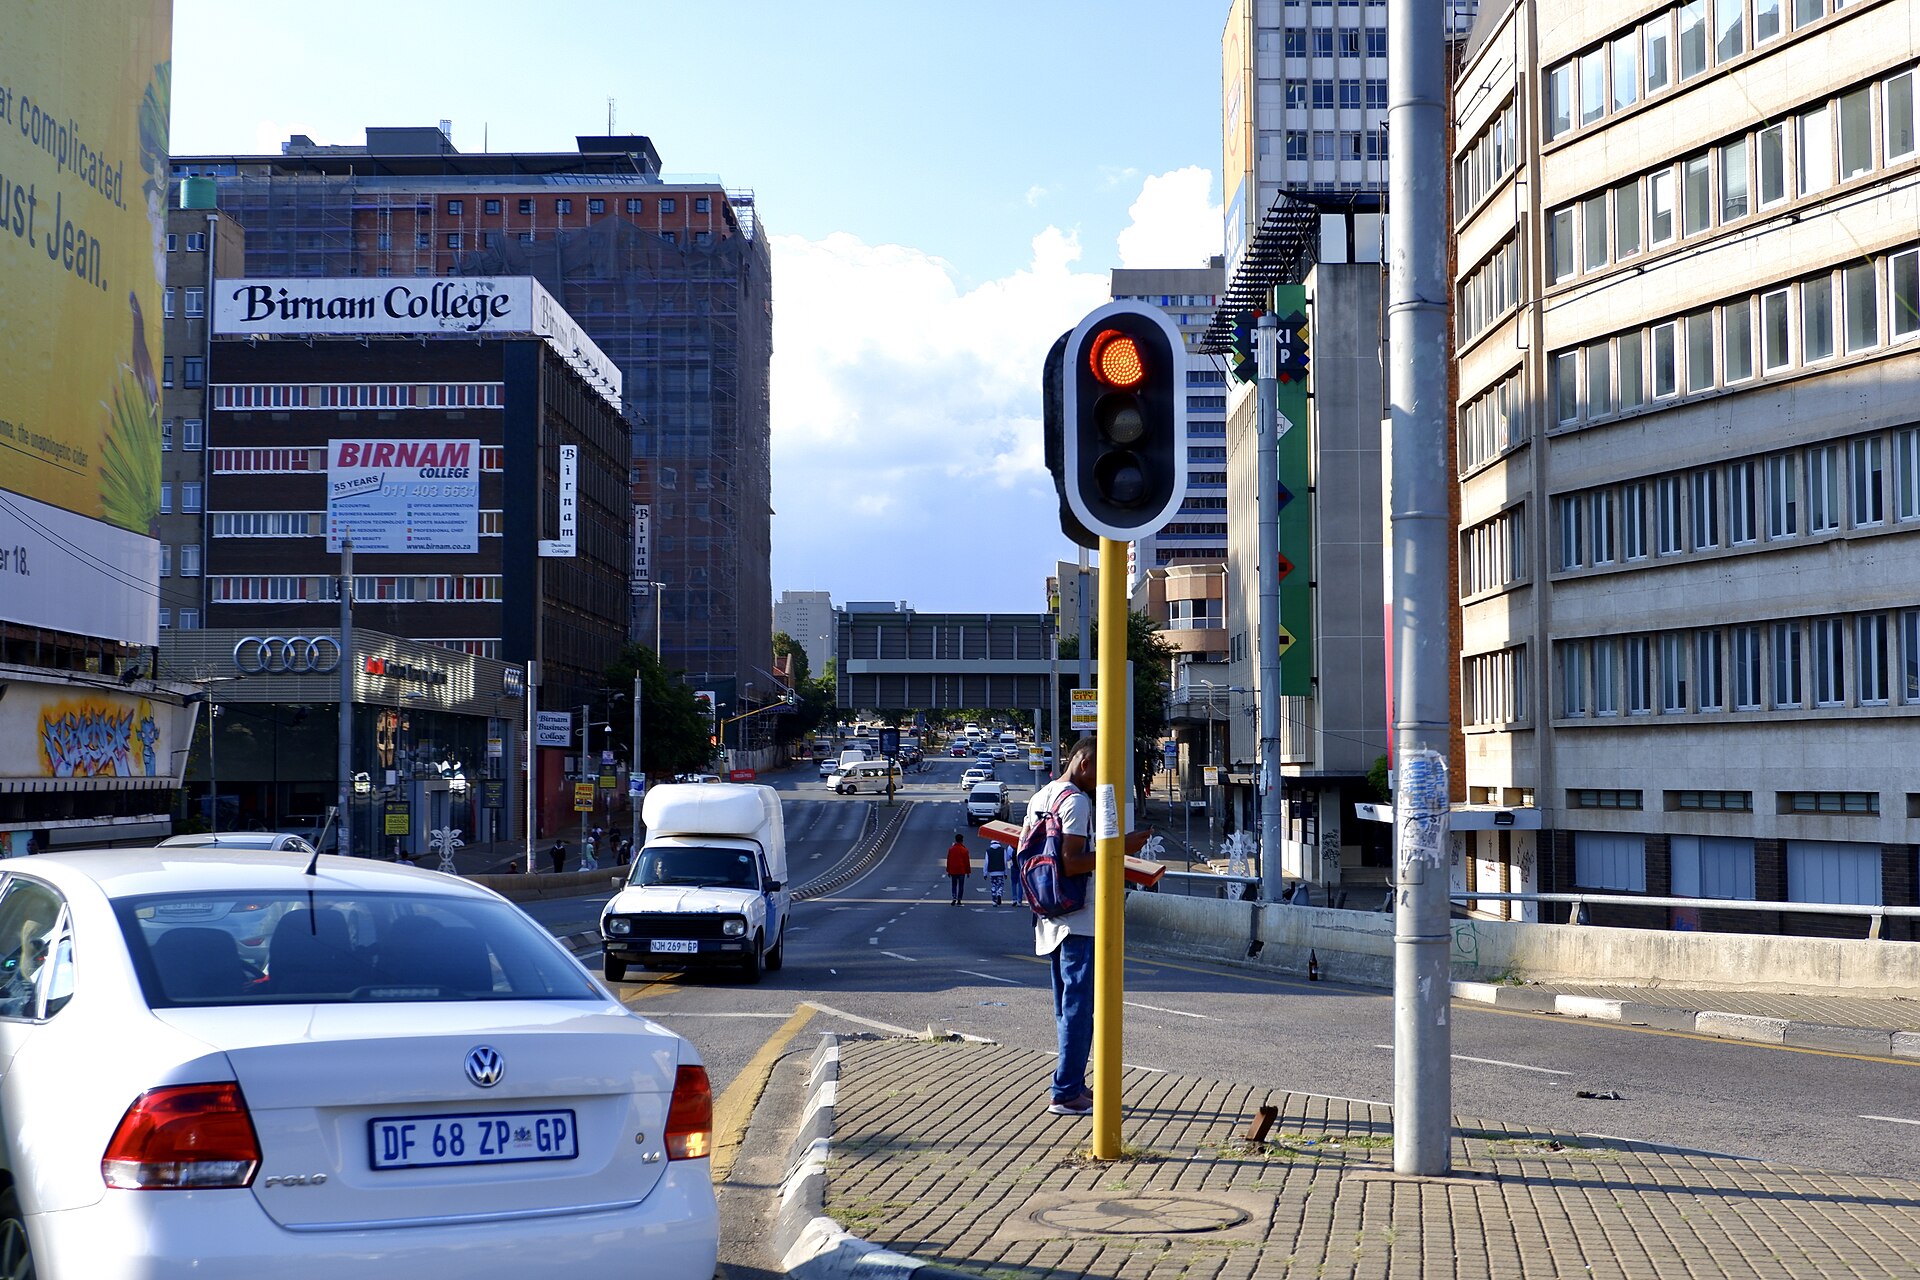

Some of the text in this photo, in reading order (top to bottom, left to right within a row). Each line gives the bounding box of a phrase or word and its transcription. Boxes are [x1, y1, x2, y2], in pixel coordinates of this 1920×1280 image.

[20, 96, 127, 211] complicated.
[47, 191, 107, 291] Jean.
[232, 281, 512, 332] Birnam College
[1250, 328, 1290, 344] PKI
[1250, 348, 1290, 364] TP
[337, 442, 470, 468] BIRNAM
[419, 468, 470, 478] COLLEGE
[334, 482, 346, 492] 55
[346, 475, 379, 488] YEARS
[382, 484, 408, 498] 011
[412, 484, 438, 498] 403
[442, 484, 477, 498] 6631
[562, 448, 575, 536] Birnam
[636, 508, 648, 577] Birnam
[13, 545, 30, 576] 18.
[536, 723, 570, 731] Business
[540, 732, 566, 741] College
[651, 941, 698, 952] NJH 269 GP
[382, 1118, 567, 1160] DF 68 ZP GP
[264, 1172, 328, 1188] POLO
